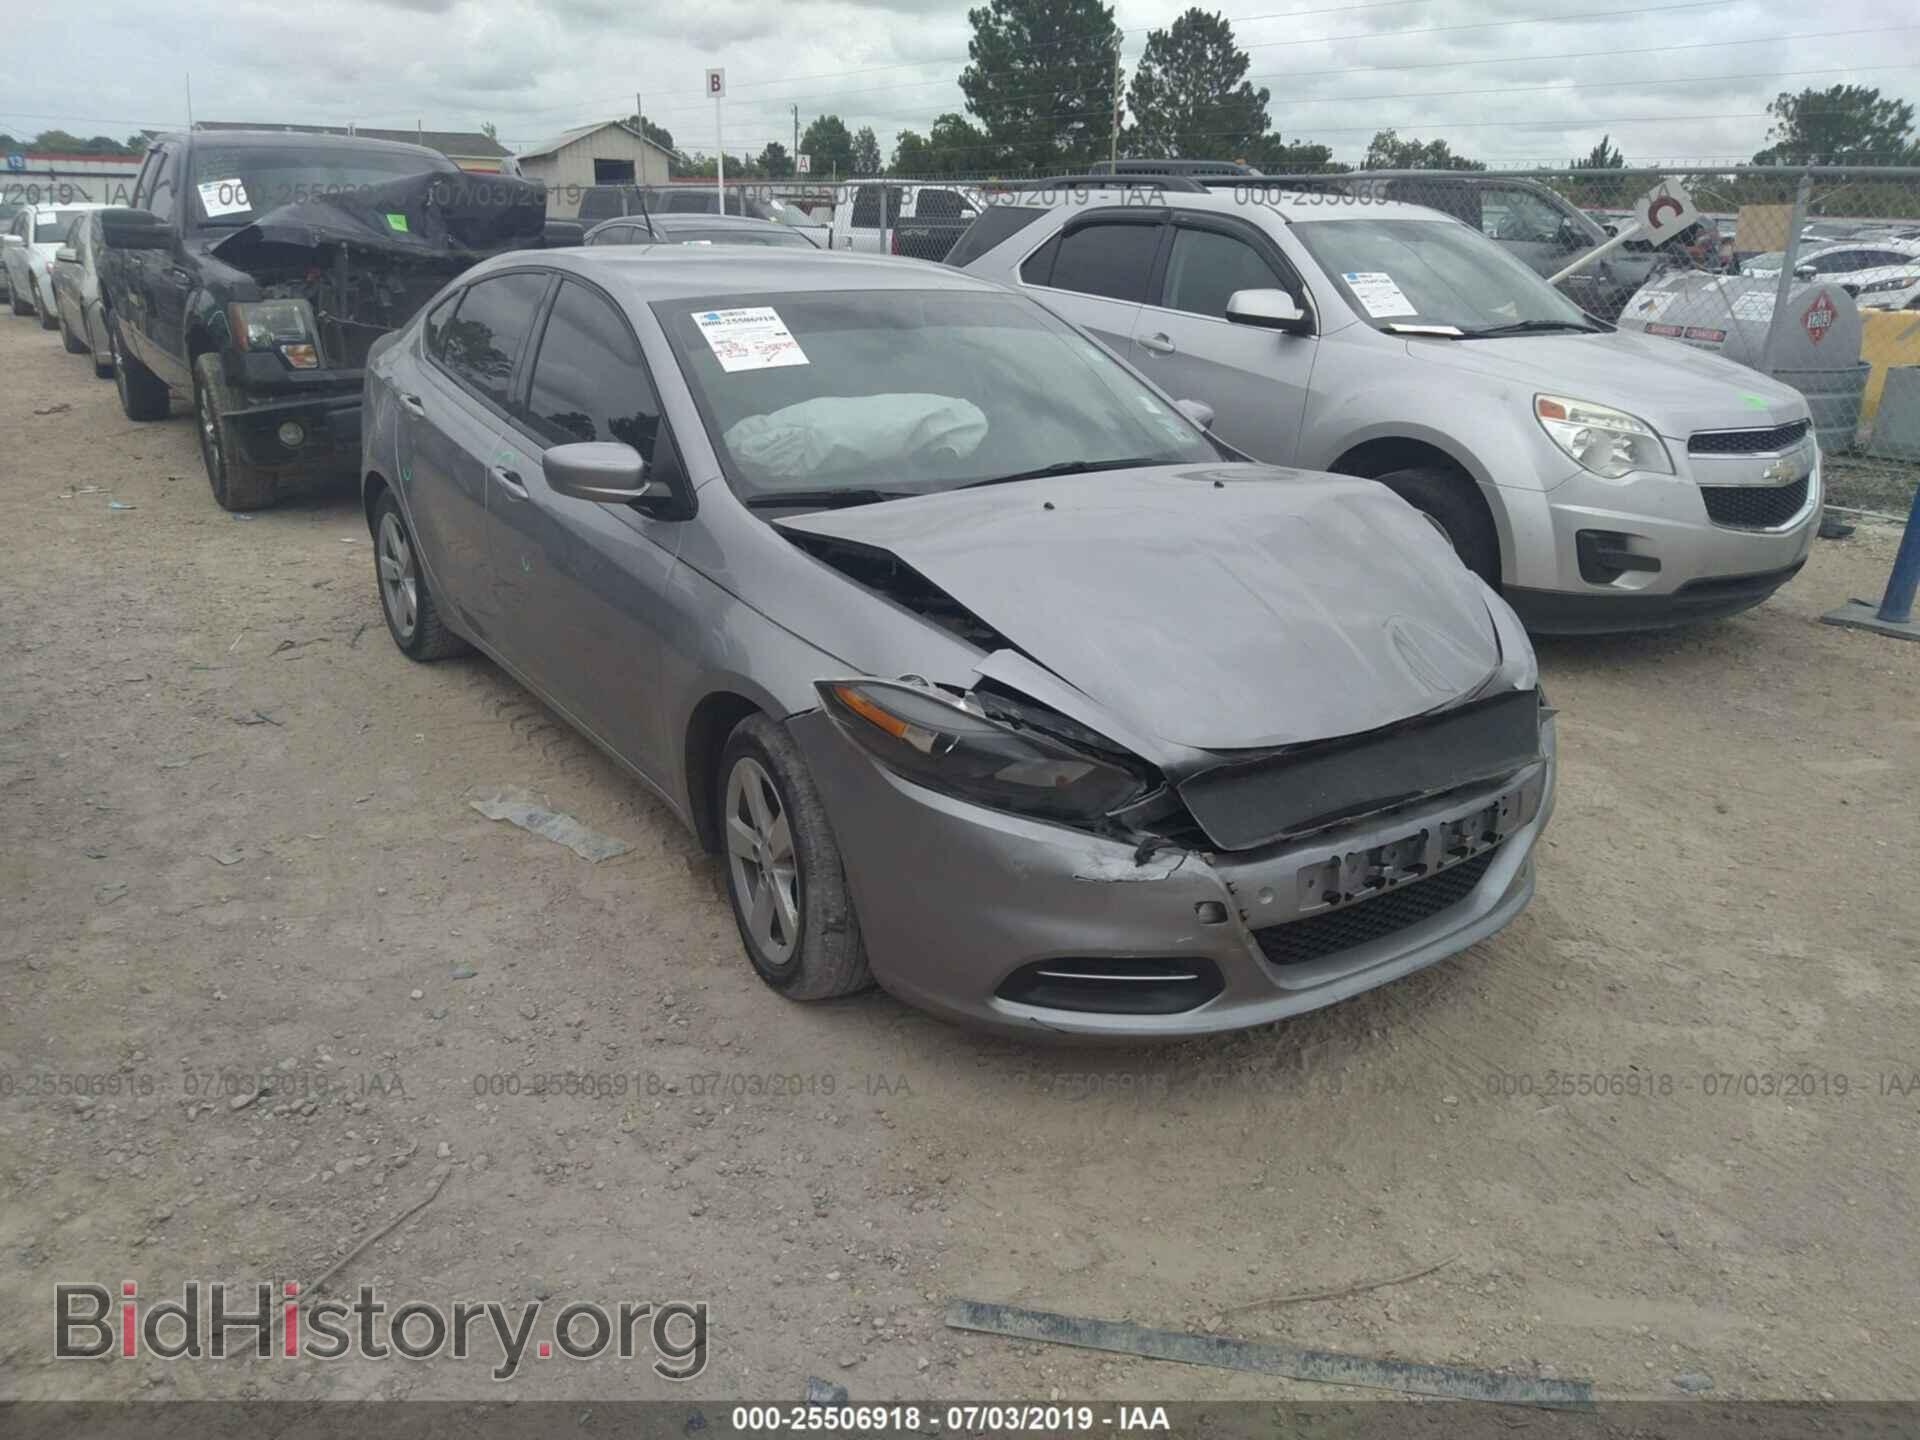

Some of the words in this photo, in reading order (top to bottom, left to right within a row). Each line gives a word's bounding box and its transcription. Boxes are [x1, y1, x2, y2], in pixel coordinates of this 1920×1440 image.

[711, 74, 721, 92] B
[800, 157, 809, 171] A
[1648, 195, 1684, 229] C
